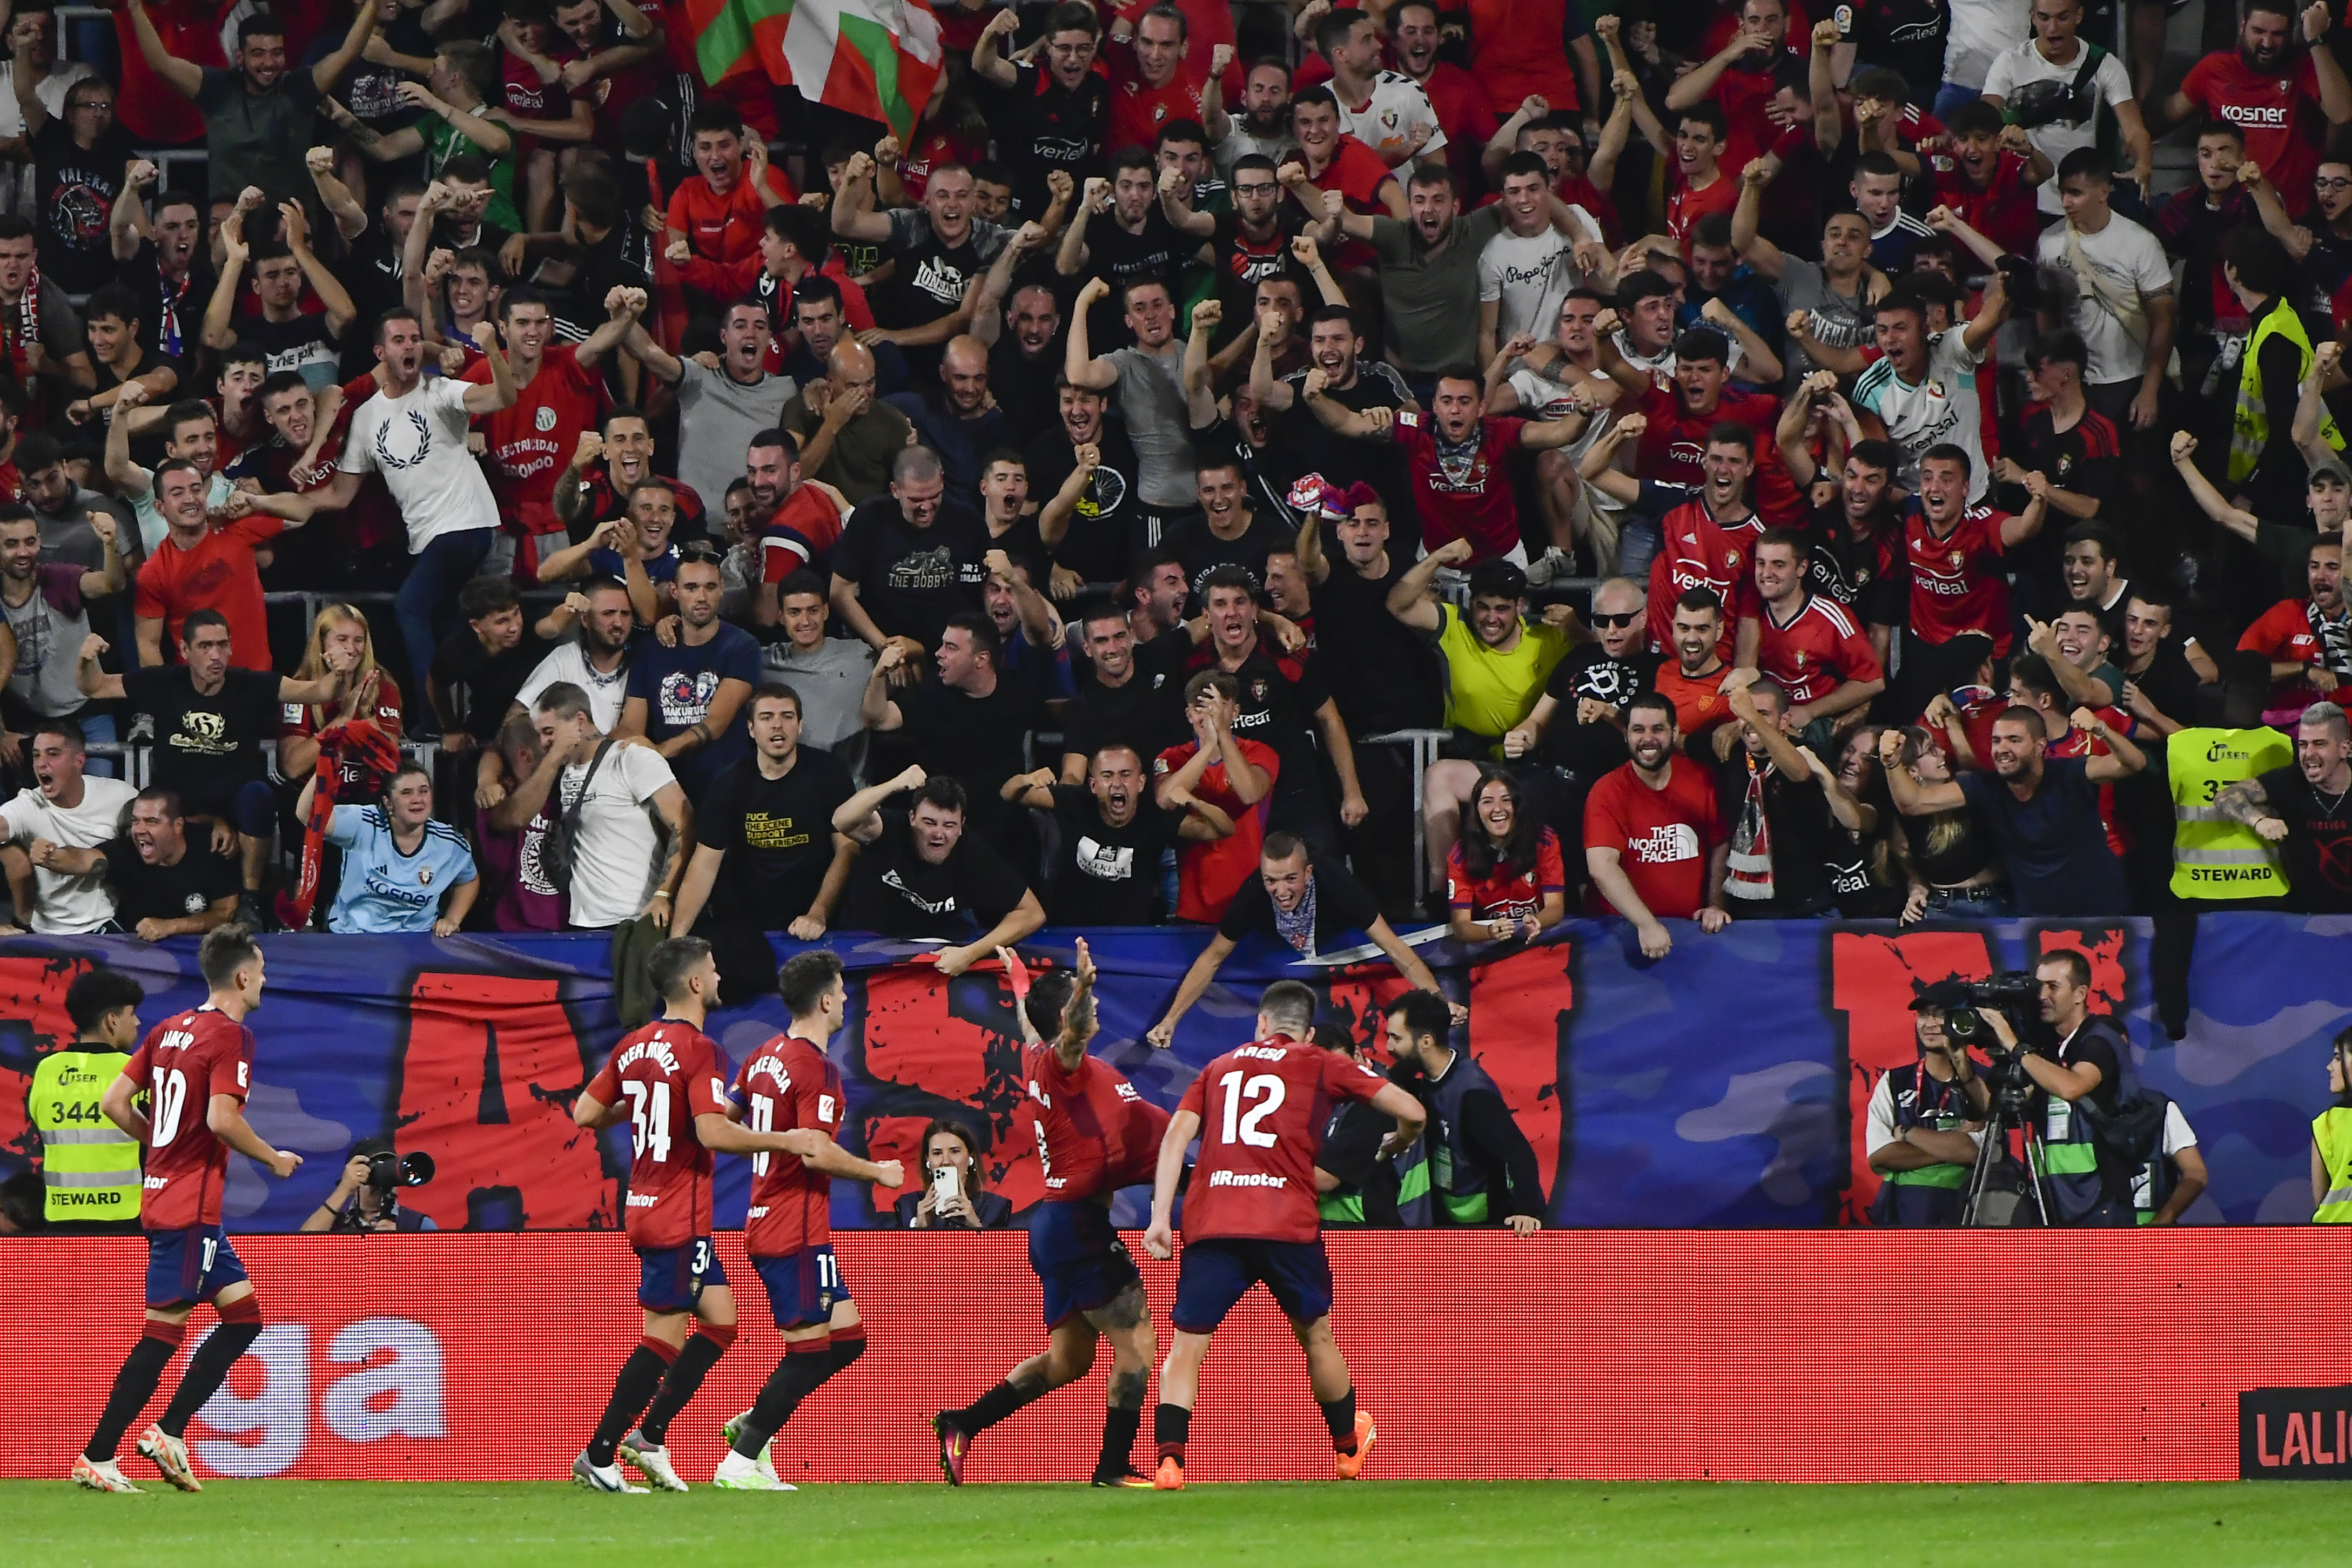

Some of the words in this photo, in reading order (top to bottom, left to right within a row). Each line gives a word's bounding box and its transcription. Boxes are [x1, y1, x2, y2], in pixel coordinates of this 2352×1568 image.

[2220, 105, 2286, 122] Kosner
[1506, 266, 1540, 284] Pepe
[276, 354, 295, 368] THE
[889, 573, 909, 587] THE
[746, 812, 769, 821] FUCK
[747, 823, 762, 831] THE
[763, 819, 790, 830] SCENE
[747, 829, 785, 840] SUPPORT
[1650, 824, 1677, 838] THE
[772, 835, 808, 847] FRIENDS
[1628, 836, 1677, 852] NORTH
[1641, 850, 1677, 864] FACE
[2191, 867, 2273, 882] STEWARD
[366, 878, 434, 907] Kosner
[617, 1042, 645, 1074] IKER
[1233, 1046, 1287, 1062] ARESO
[52, 1101, 102, 1123] 344
[152, 1065, 187, 1148] 10
[1219, 1069, 1286, 1149] 12
[621, 1080, 671, 1163] 34
[750, 1092, 774, 1178] 11
[1209, 1169, 1288, 1188] HRmotor
[51, 1192, 122, 1206] STEWARD
[201, 1237, 218, 1273] 10
[816, 1253, 838, 1289] 11
[186, 1316, 447, 1478] ga
[2256, 1410, 2352, 1467] LALI
